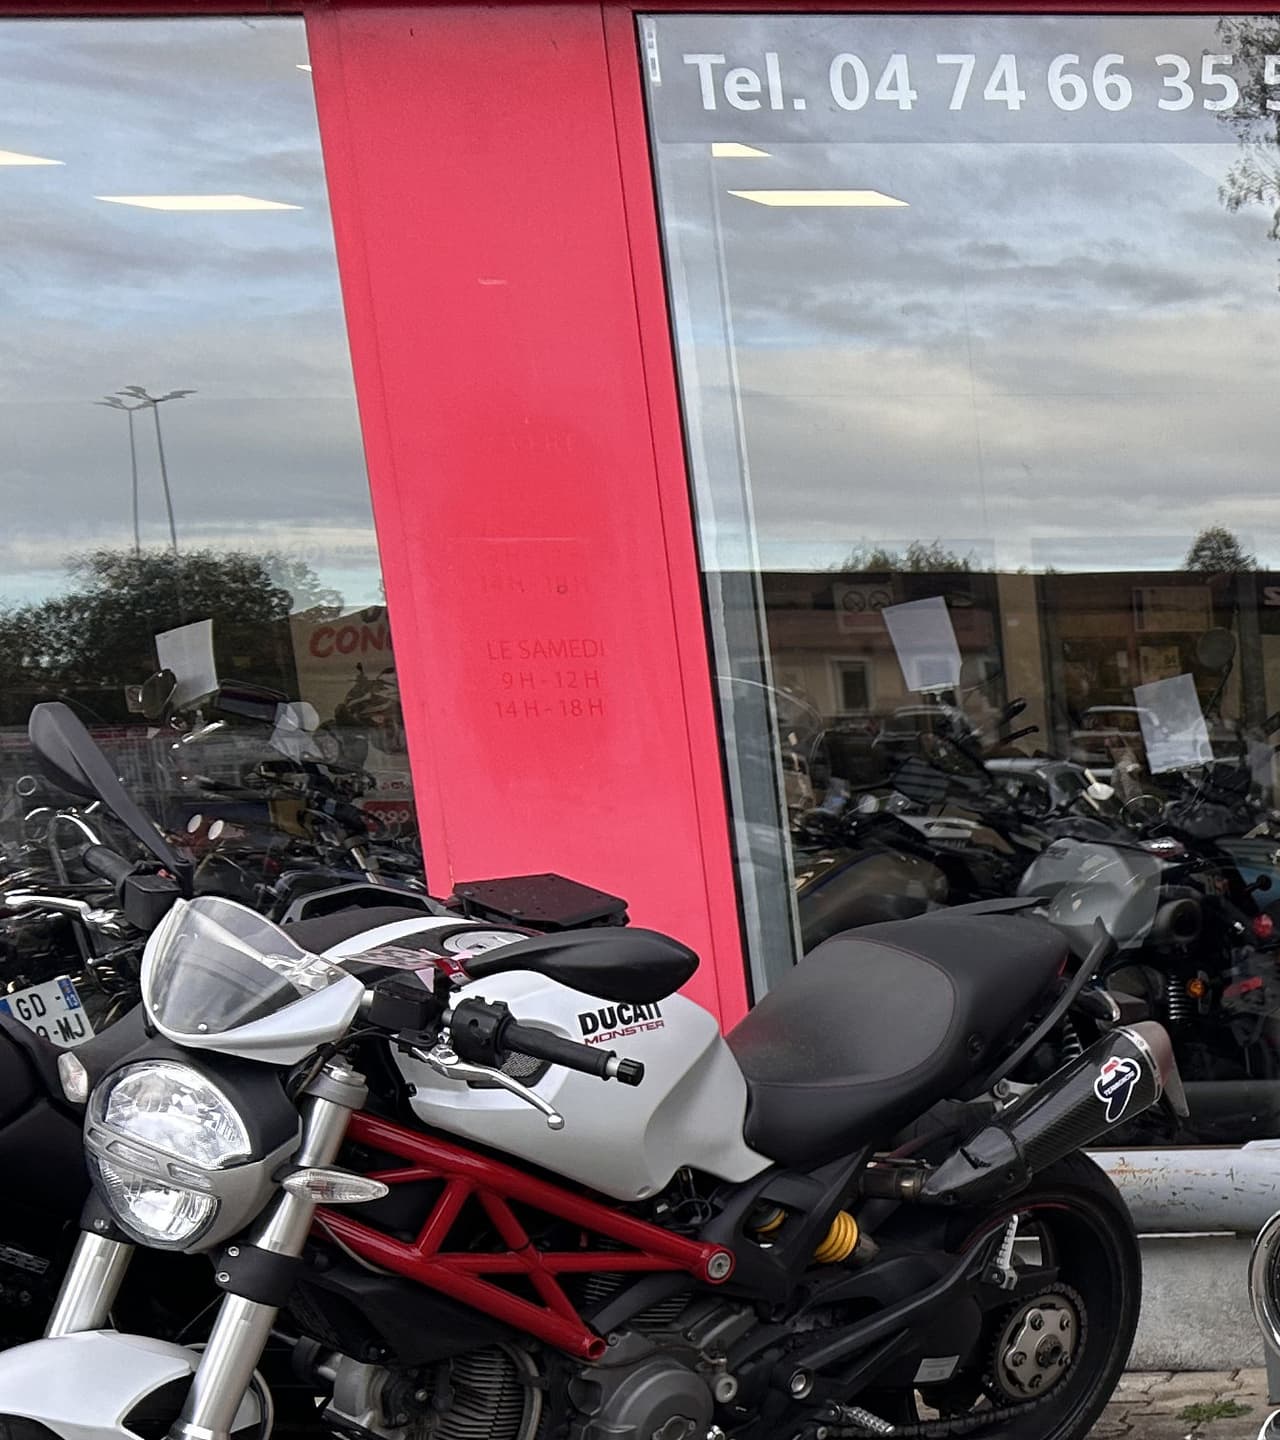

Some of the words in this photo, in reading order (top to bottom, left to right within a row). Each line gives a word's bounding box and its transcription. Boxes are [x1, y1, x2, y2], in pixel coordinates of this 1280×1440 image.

[683, 53, 806, 112] Tel.
[829, 53, 918, 112] 04
[935, 53, 1026, 112] 74
[1047, 53, 1134, 112] 66
[1155, 53, 1241, 112] 35
[309, 624, 391, 658] CON
[487, 640, 514, 661] LE
[518, 638, 605, 660] SAMEDI
[495, 701, 518, 718] 14
[524, 700, 541, 717] H
[560, 699, 583, 717] 18
[589, 698, 605, 716] H
[16, 993, 47, 1021] GD
[578, 1002, 662, 1036] DUCATI
[584, 1019, 665, 1046] MONSTER
